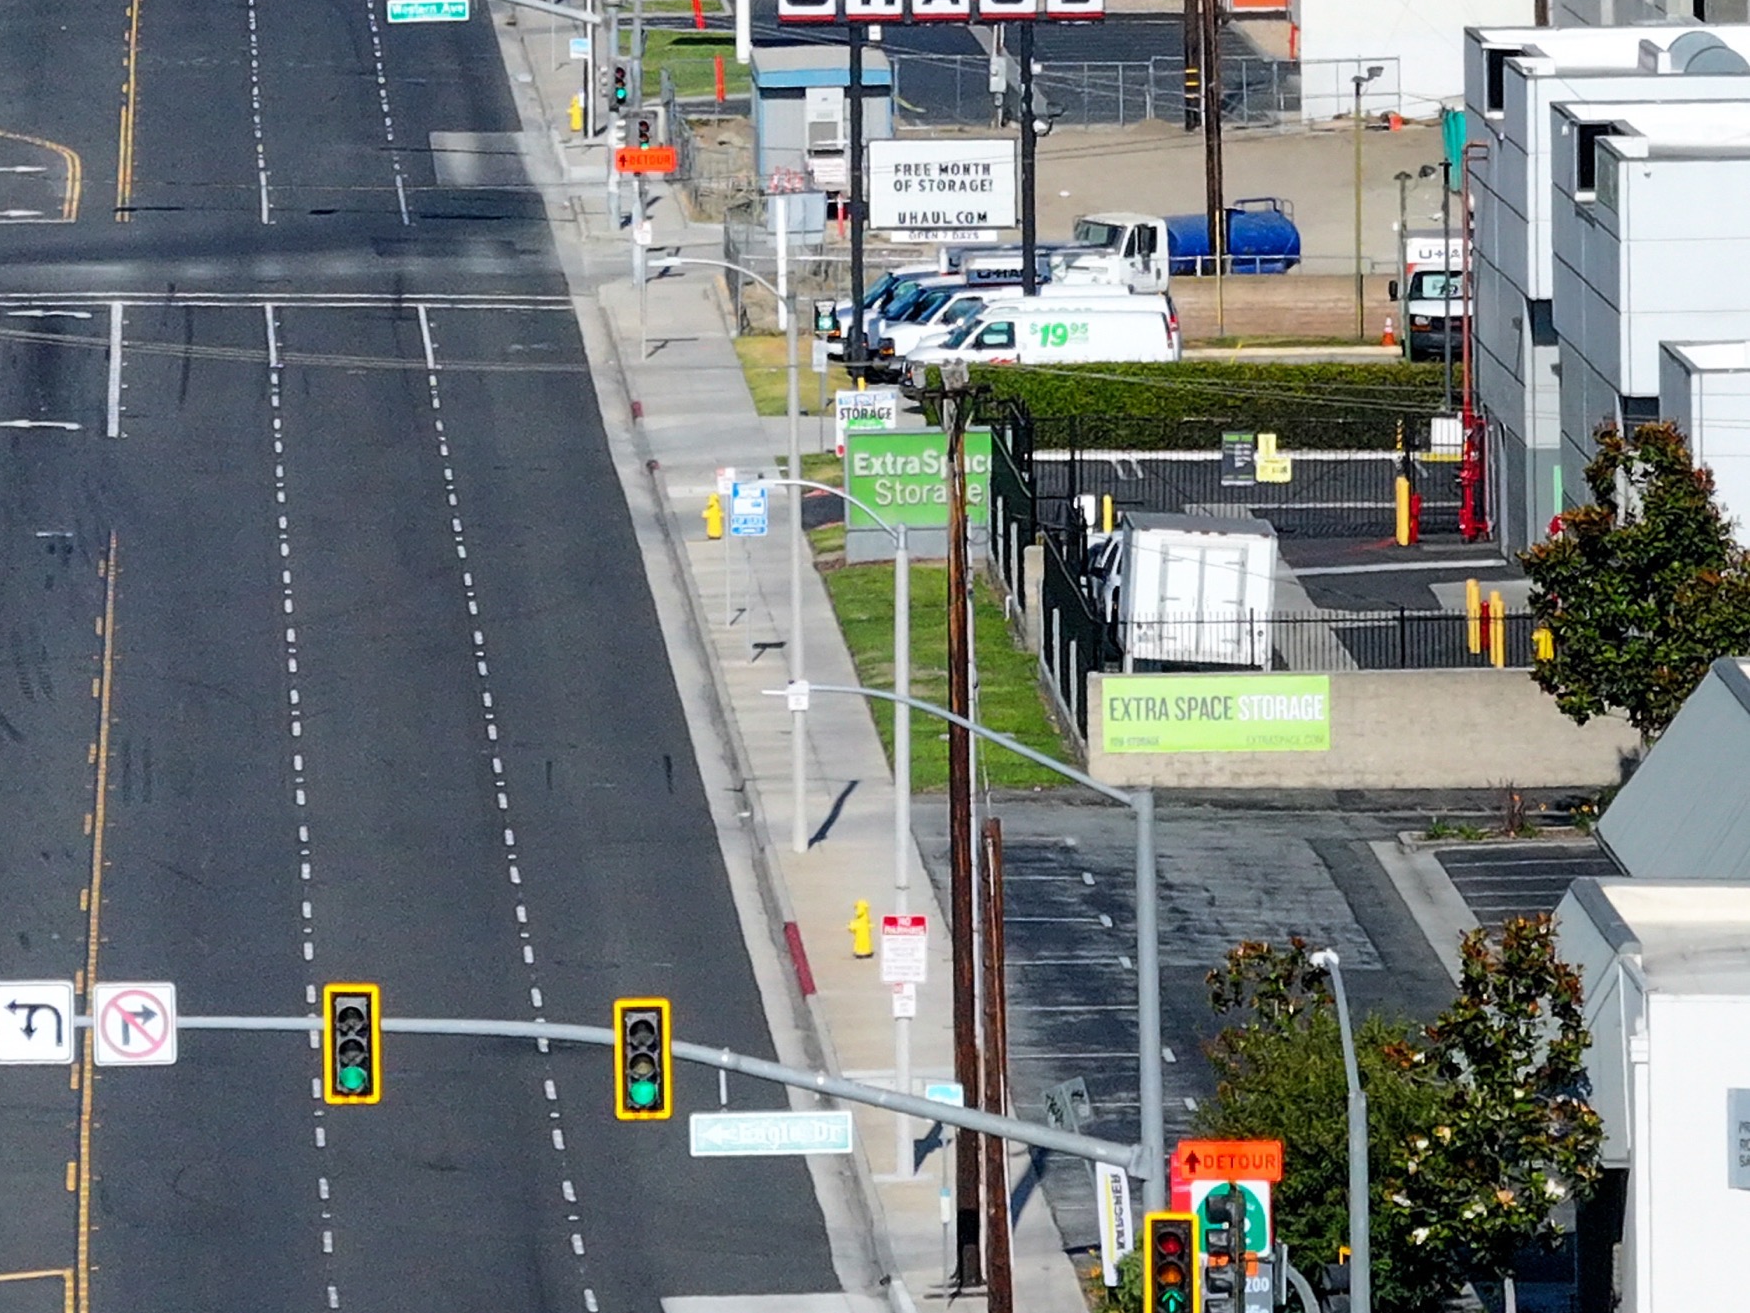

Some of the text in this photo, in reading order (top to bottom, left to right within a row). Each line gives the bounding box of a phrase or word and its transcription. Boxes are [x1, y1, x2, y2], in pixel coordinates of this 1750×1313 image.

[630, 154, 671, 165] DETOUR
[893, 163, 992, 176] FREE MONTH
[893, 179, 994, 192] OF STORAGE!
[908, 231, 939, 240] OPEN
[839, 407, 892, 420] STORAGE
[874, 479, 983, 506] Storae
[1109, 694, 1325, 722] EXTRA SPACE STORAGE
[1203, 1153, 1277, 1170] DETOUR
